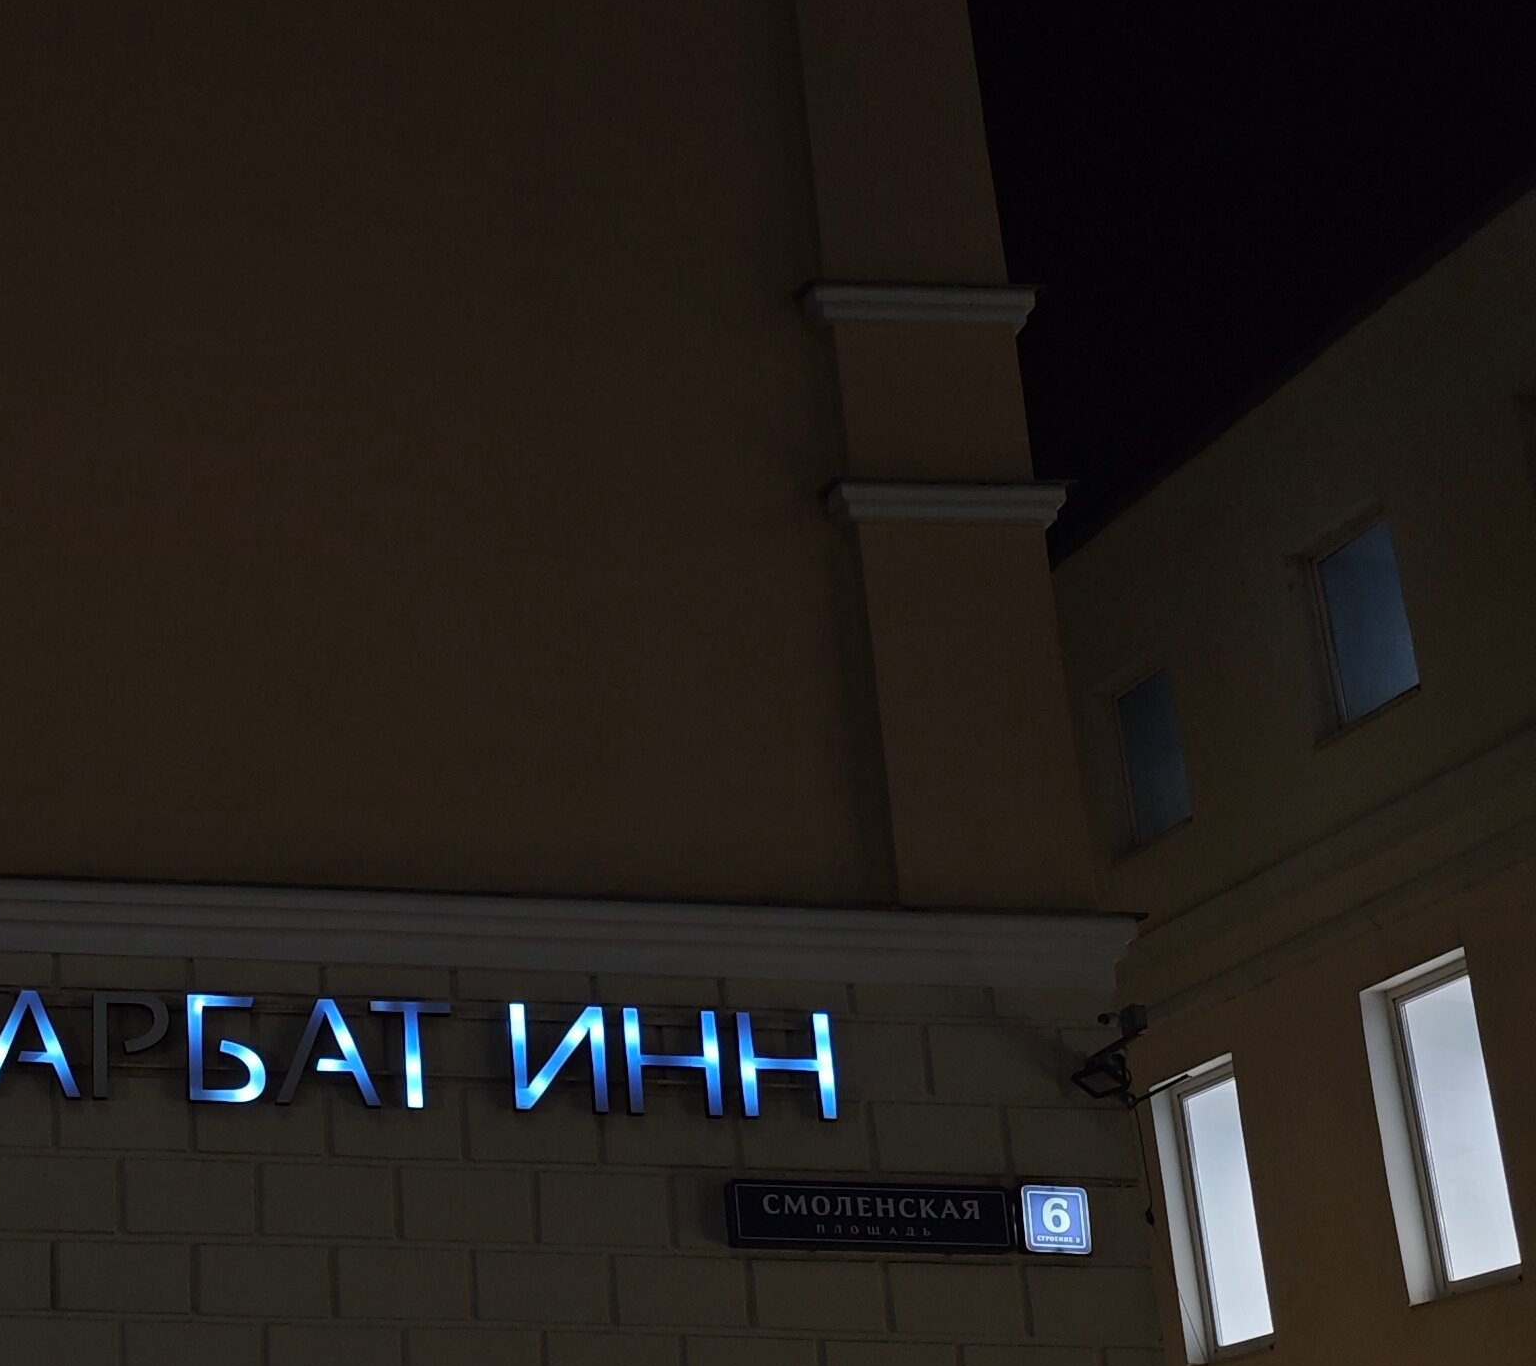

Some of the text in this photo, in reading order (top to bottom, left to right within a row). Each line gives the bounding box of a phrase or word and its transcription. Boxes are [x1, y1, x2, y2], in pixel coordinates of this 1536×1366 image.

[508, 1001, 839, 1121] ИНН
[762, 1193, 981, 1220] СМОЛЕНСКАЯ
[1042, 1197, 1071, 1233] 6
[815, 1223, 933, 1237] ПЛОЩАДЬ
